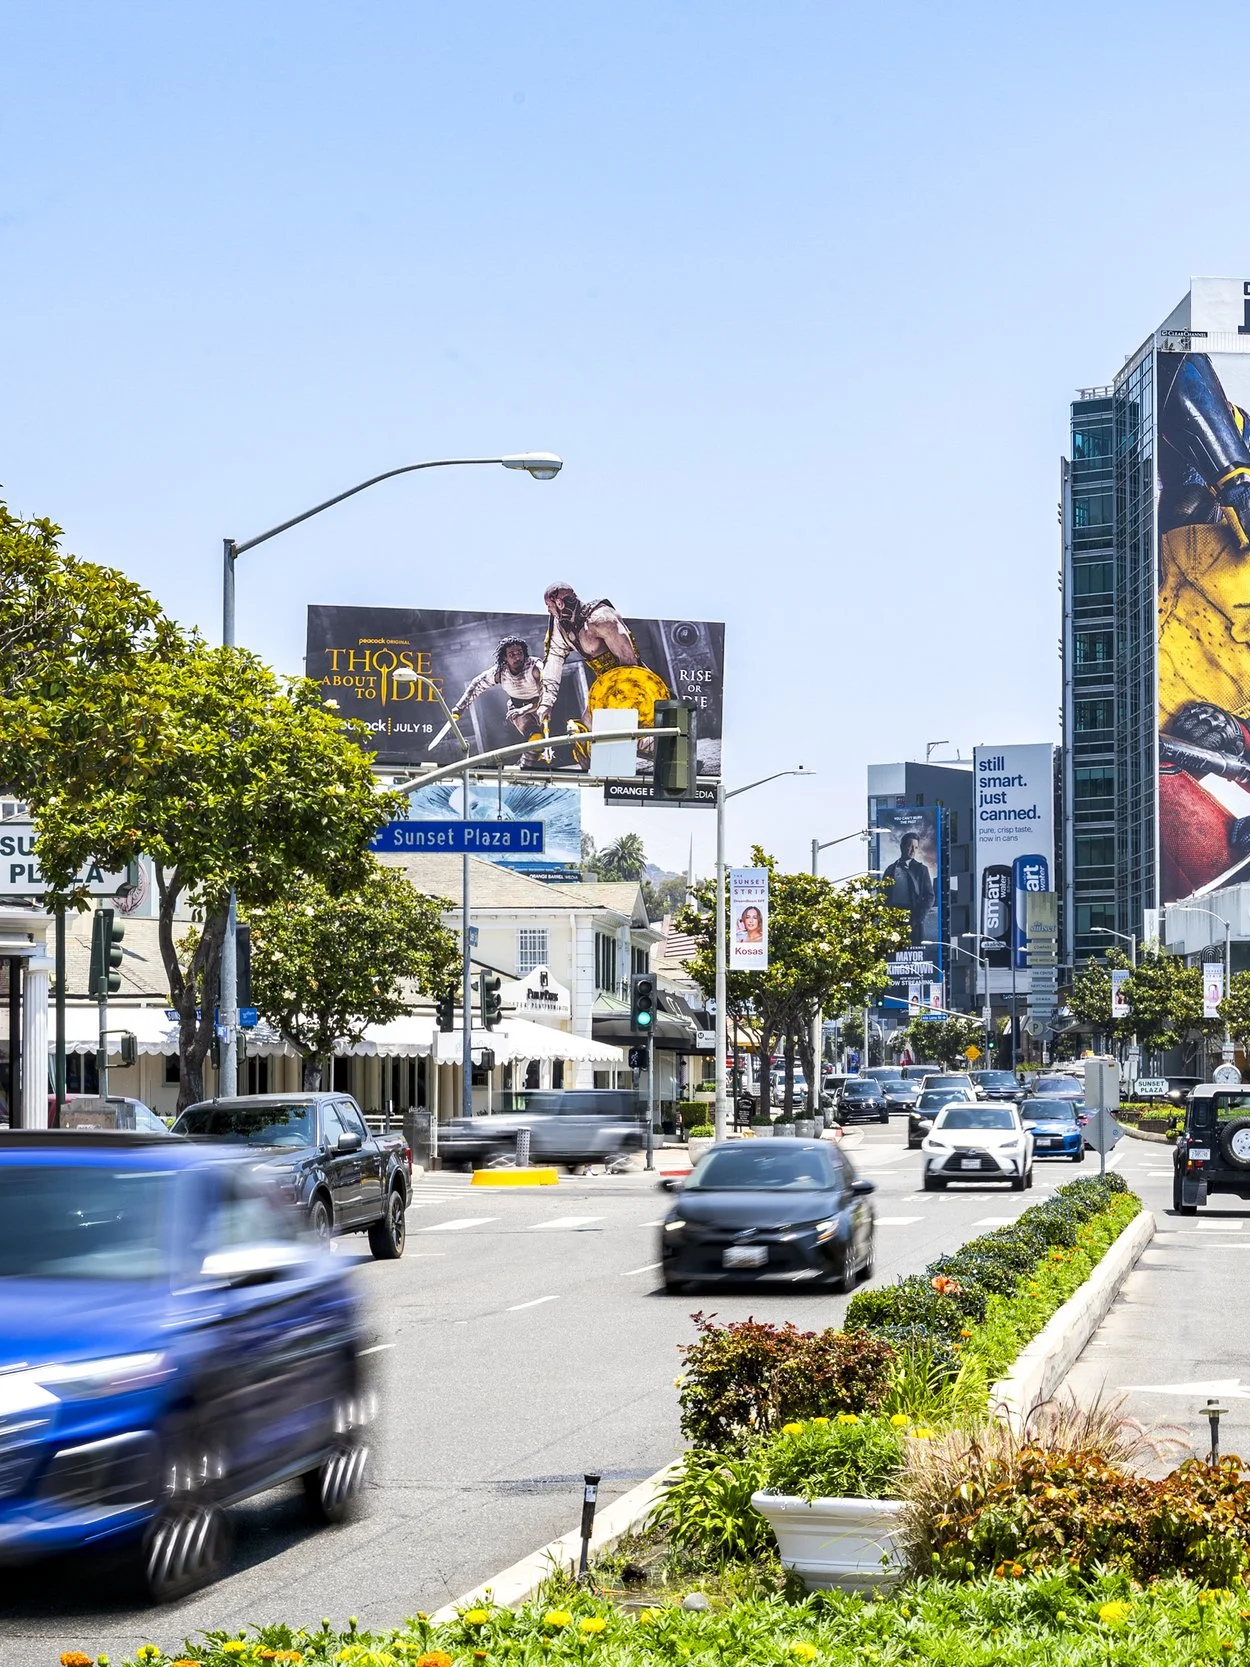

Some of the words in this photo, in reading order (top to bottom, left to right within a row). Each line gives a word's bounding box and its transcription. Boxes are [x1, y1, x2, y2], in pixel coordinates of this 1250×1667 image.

[359, 637, 386, 646] peacock
[324, 647, 433, 675] THOSE
[321, 675, 377, 686] ABOUT
[679, 670, 712, 682] RISE
[355, 688, 377, 699] TO
[391, 677, 445, 702] DIE
[687, 685, 702, 693] OR
[393, 722, 421, 733] JULY
[422, 724, 433, 733] 18
[979, 756, 1004, 771] still
[979, 774, 1027, 788] smart.
[610, 786, 648, 796] ORANGE
[694, 787, 715, 799] EDIA
[979, 790, 1007, 808] just
[980, 804, 1041, 821] canned.
[997, 826, 1014, 834] crisp
[393, 828, 454, 846] Sunset
[464, 828, 511, 846] Plaza
[520, 828, 540, 845] Dr
[10, 864, 104, 884] PLA
[1023, 865, 1039, 892] art
[987, 874, 1000, 929] smart
[735, 947, 764, 955] Kosas
[895, 951, 923, 962] MAYOR
[886, 963, 934, 975] KINGSTOWN
